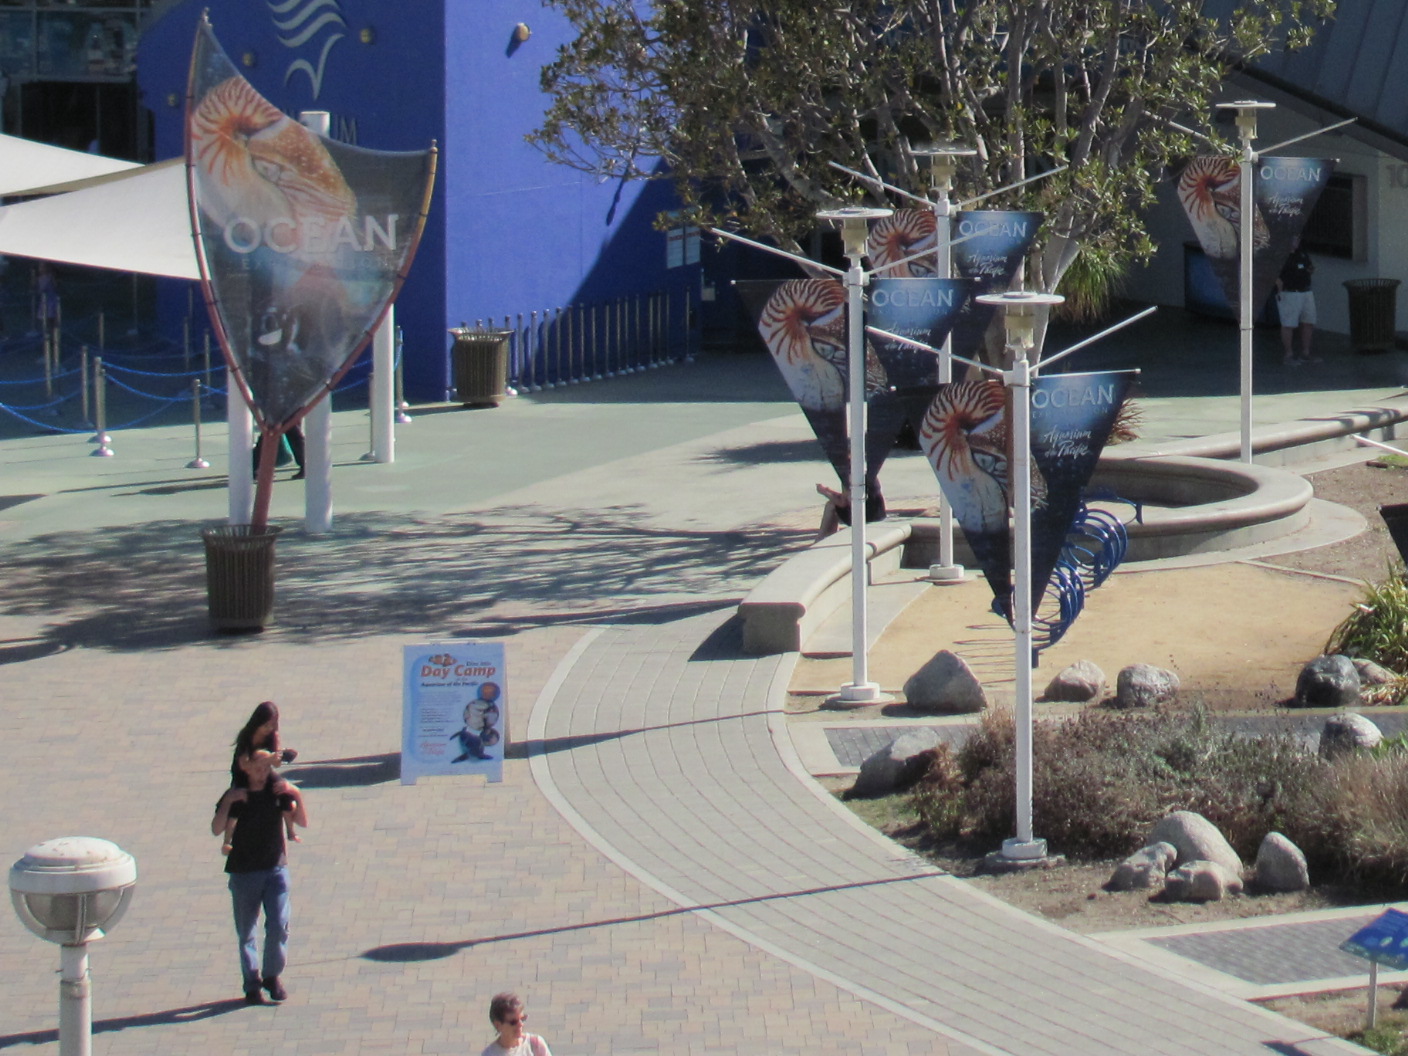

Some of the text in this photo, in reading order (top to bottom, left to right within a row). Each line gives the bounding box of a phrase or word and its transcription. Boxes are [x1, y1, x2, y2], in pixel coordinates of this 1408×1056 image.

[1260, 165, 1322, 182] OCEAN
[224, 213, 400, 254] OCEAN
[958, 220, 1028, 238] OCEAN
[871, 288, 954, 307] OCEAN
[1031, 384, 1115, 409] OCEAN
[421, 665, 496, 679] Day Camp
